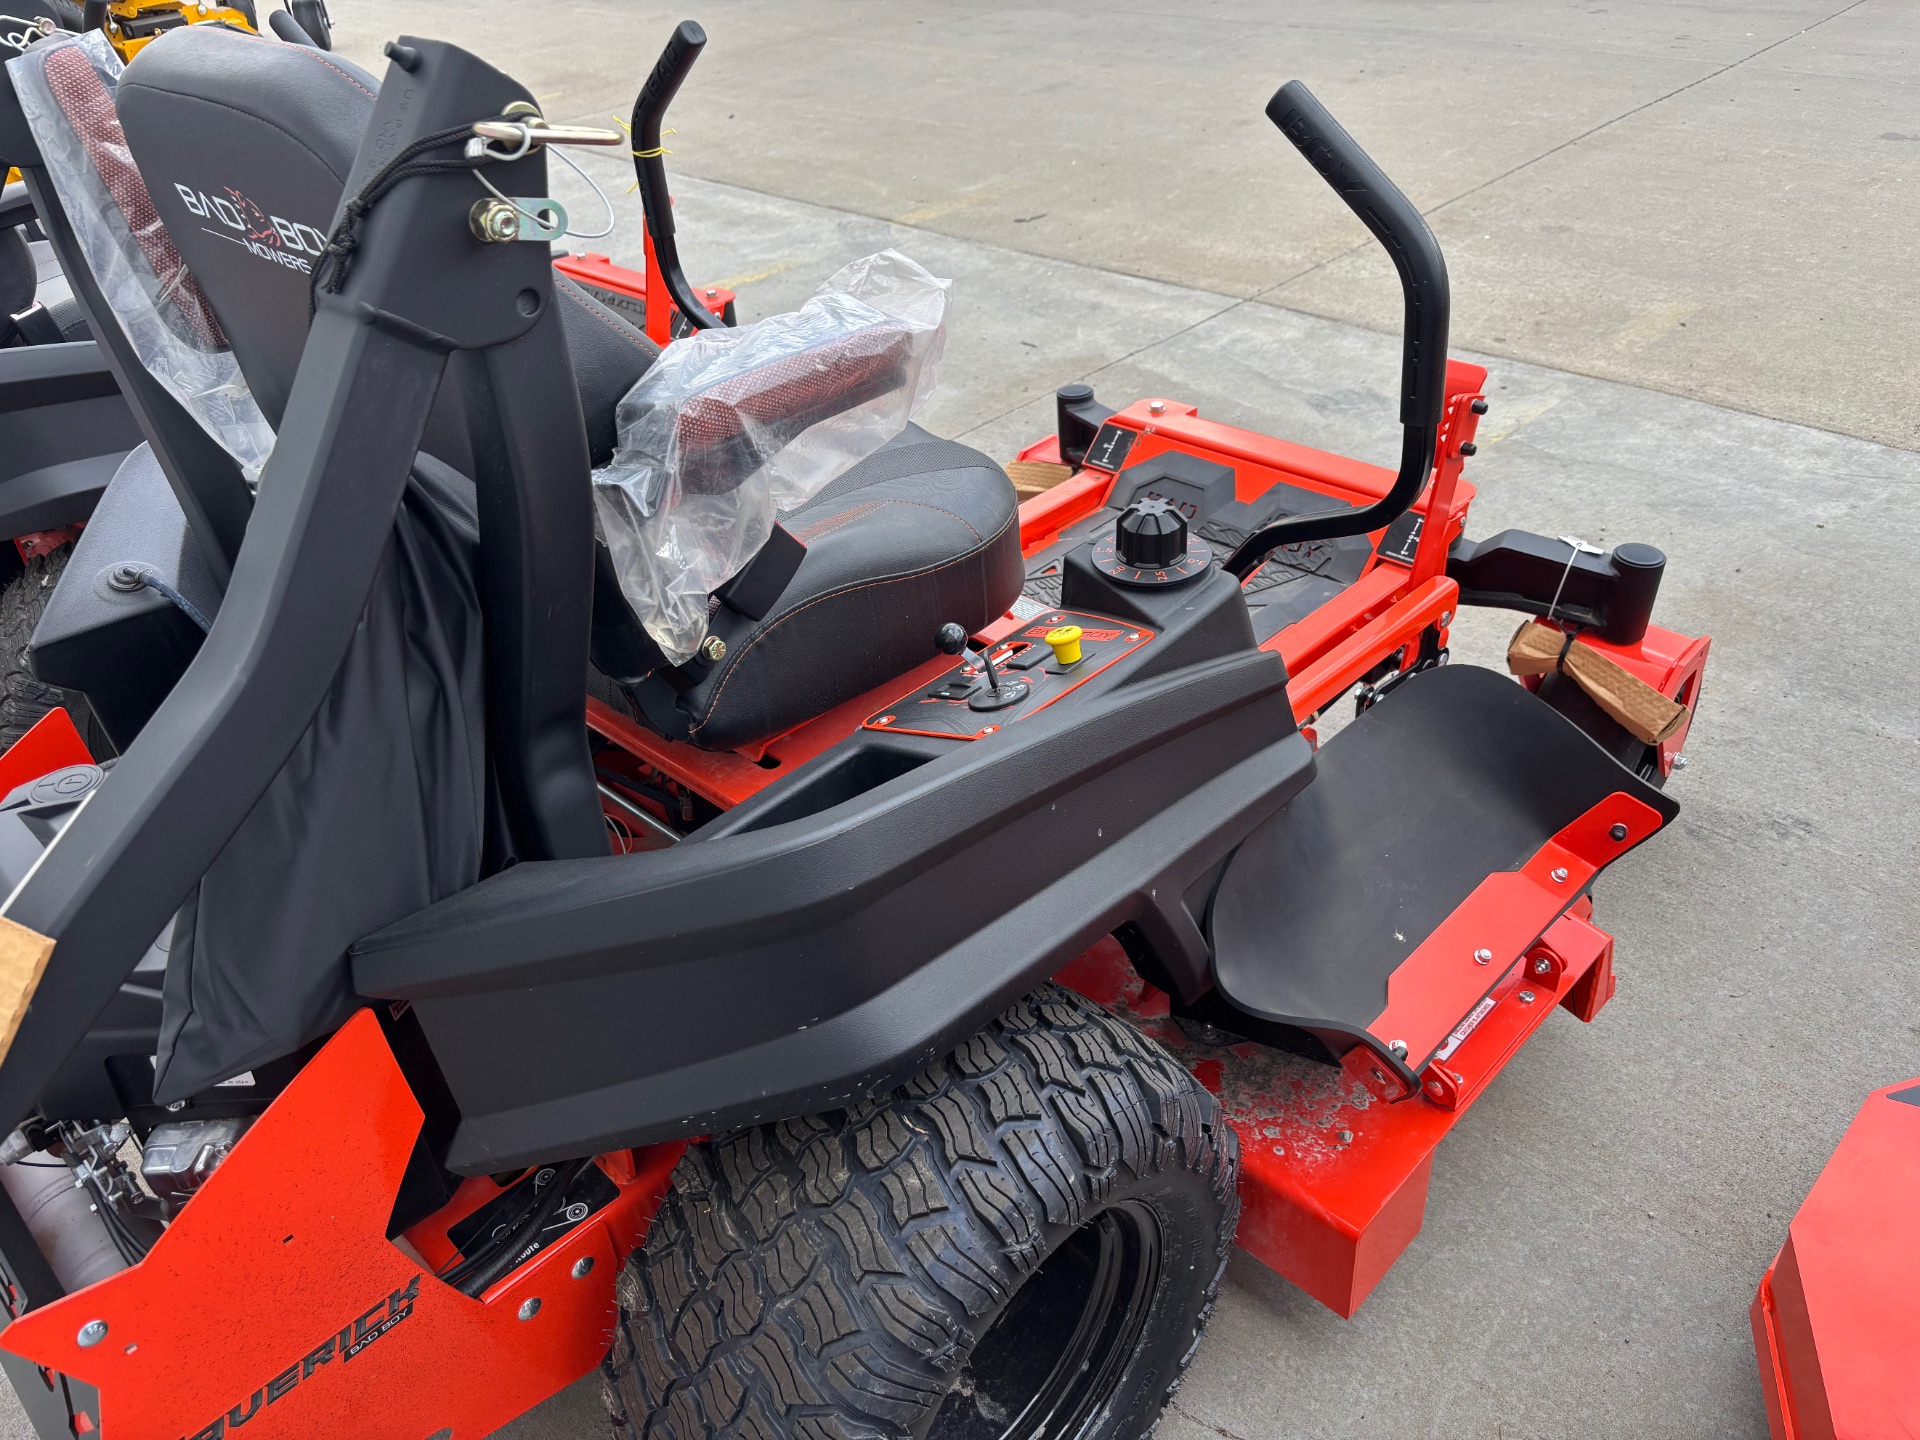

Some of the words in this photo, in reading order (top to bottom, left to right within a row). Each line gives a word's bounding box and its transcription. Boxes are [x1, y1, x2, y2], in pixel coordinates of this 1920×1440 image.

[1279, 108, 1368, 195] BOY
[174, 182, 246, 231] BAD
[242, 237, 313, 275] MOWERS
[1108, 565, 1126, 576] 2.0
[350, 1330, 378, 1355] BAD
[381, 1308, 408, 1332] BOY
[178, 1273, 421, 1440] AVERICK
